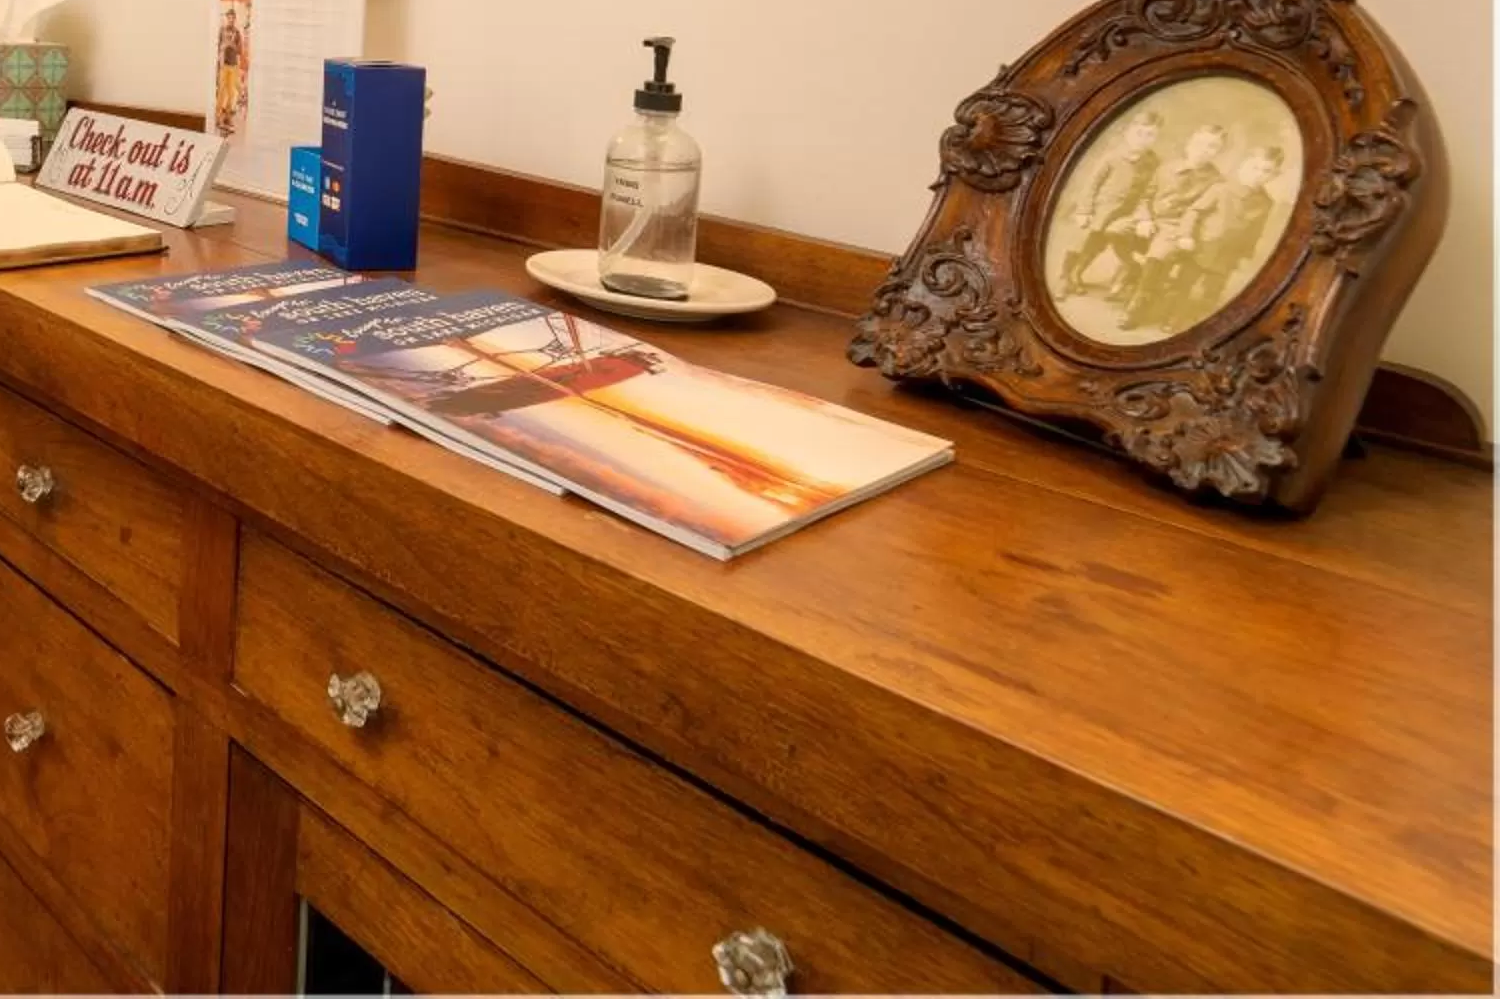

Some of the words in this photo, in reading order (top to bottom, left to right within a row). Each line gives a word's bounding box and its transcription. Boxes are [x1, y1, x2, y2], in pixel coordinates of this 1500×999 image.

[69, 116, 127, 160] Check
[127, 132, 171, 169] out
[169, 139, 195, 175] is
[67, 158, 97, 189] at
